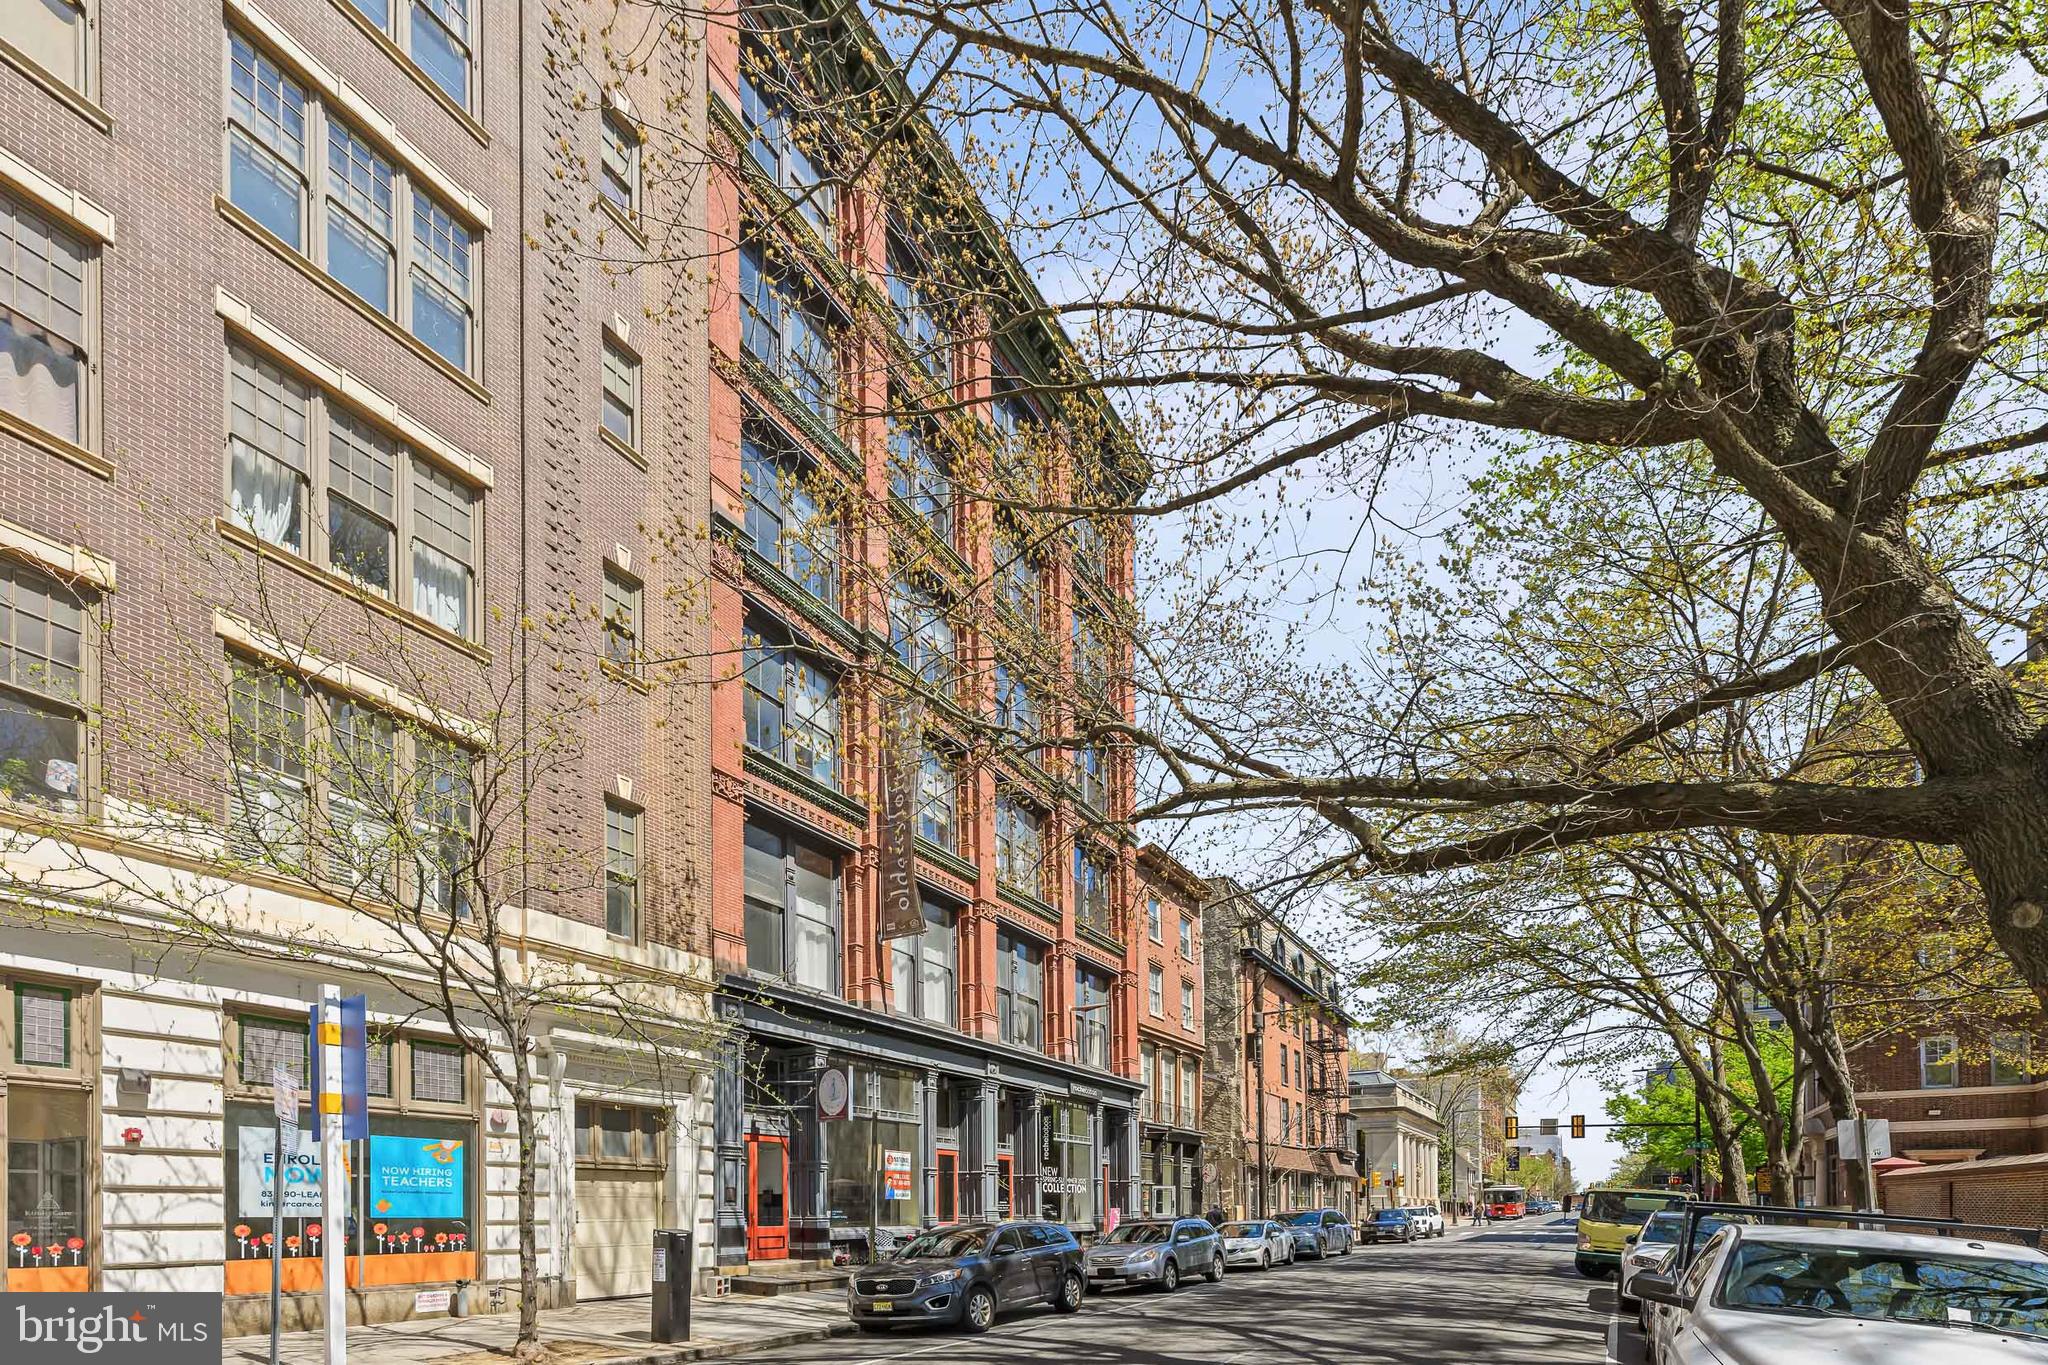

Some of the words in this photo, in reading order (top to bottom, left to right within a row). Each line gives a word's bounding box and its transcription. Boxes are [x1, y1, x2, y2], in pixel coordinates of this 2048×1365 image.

[263, 1153, 321, 1166] EROL
[382, 1166, 410, 1175] NOW
[412, 1167, 453, 1177] HIRING
[1042, 1167, 1058, 1176] NEW
[383, 1176, 454, 1188] TEACHERS
[1042, 1183, 1087, 1194] COLLECTION
